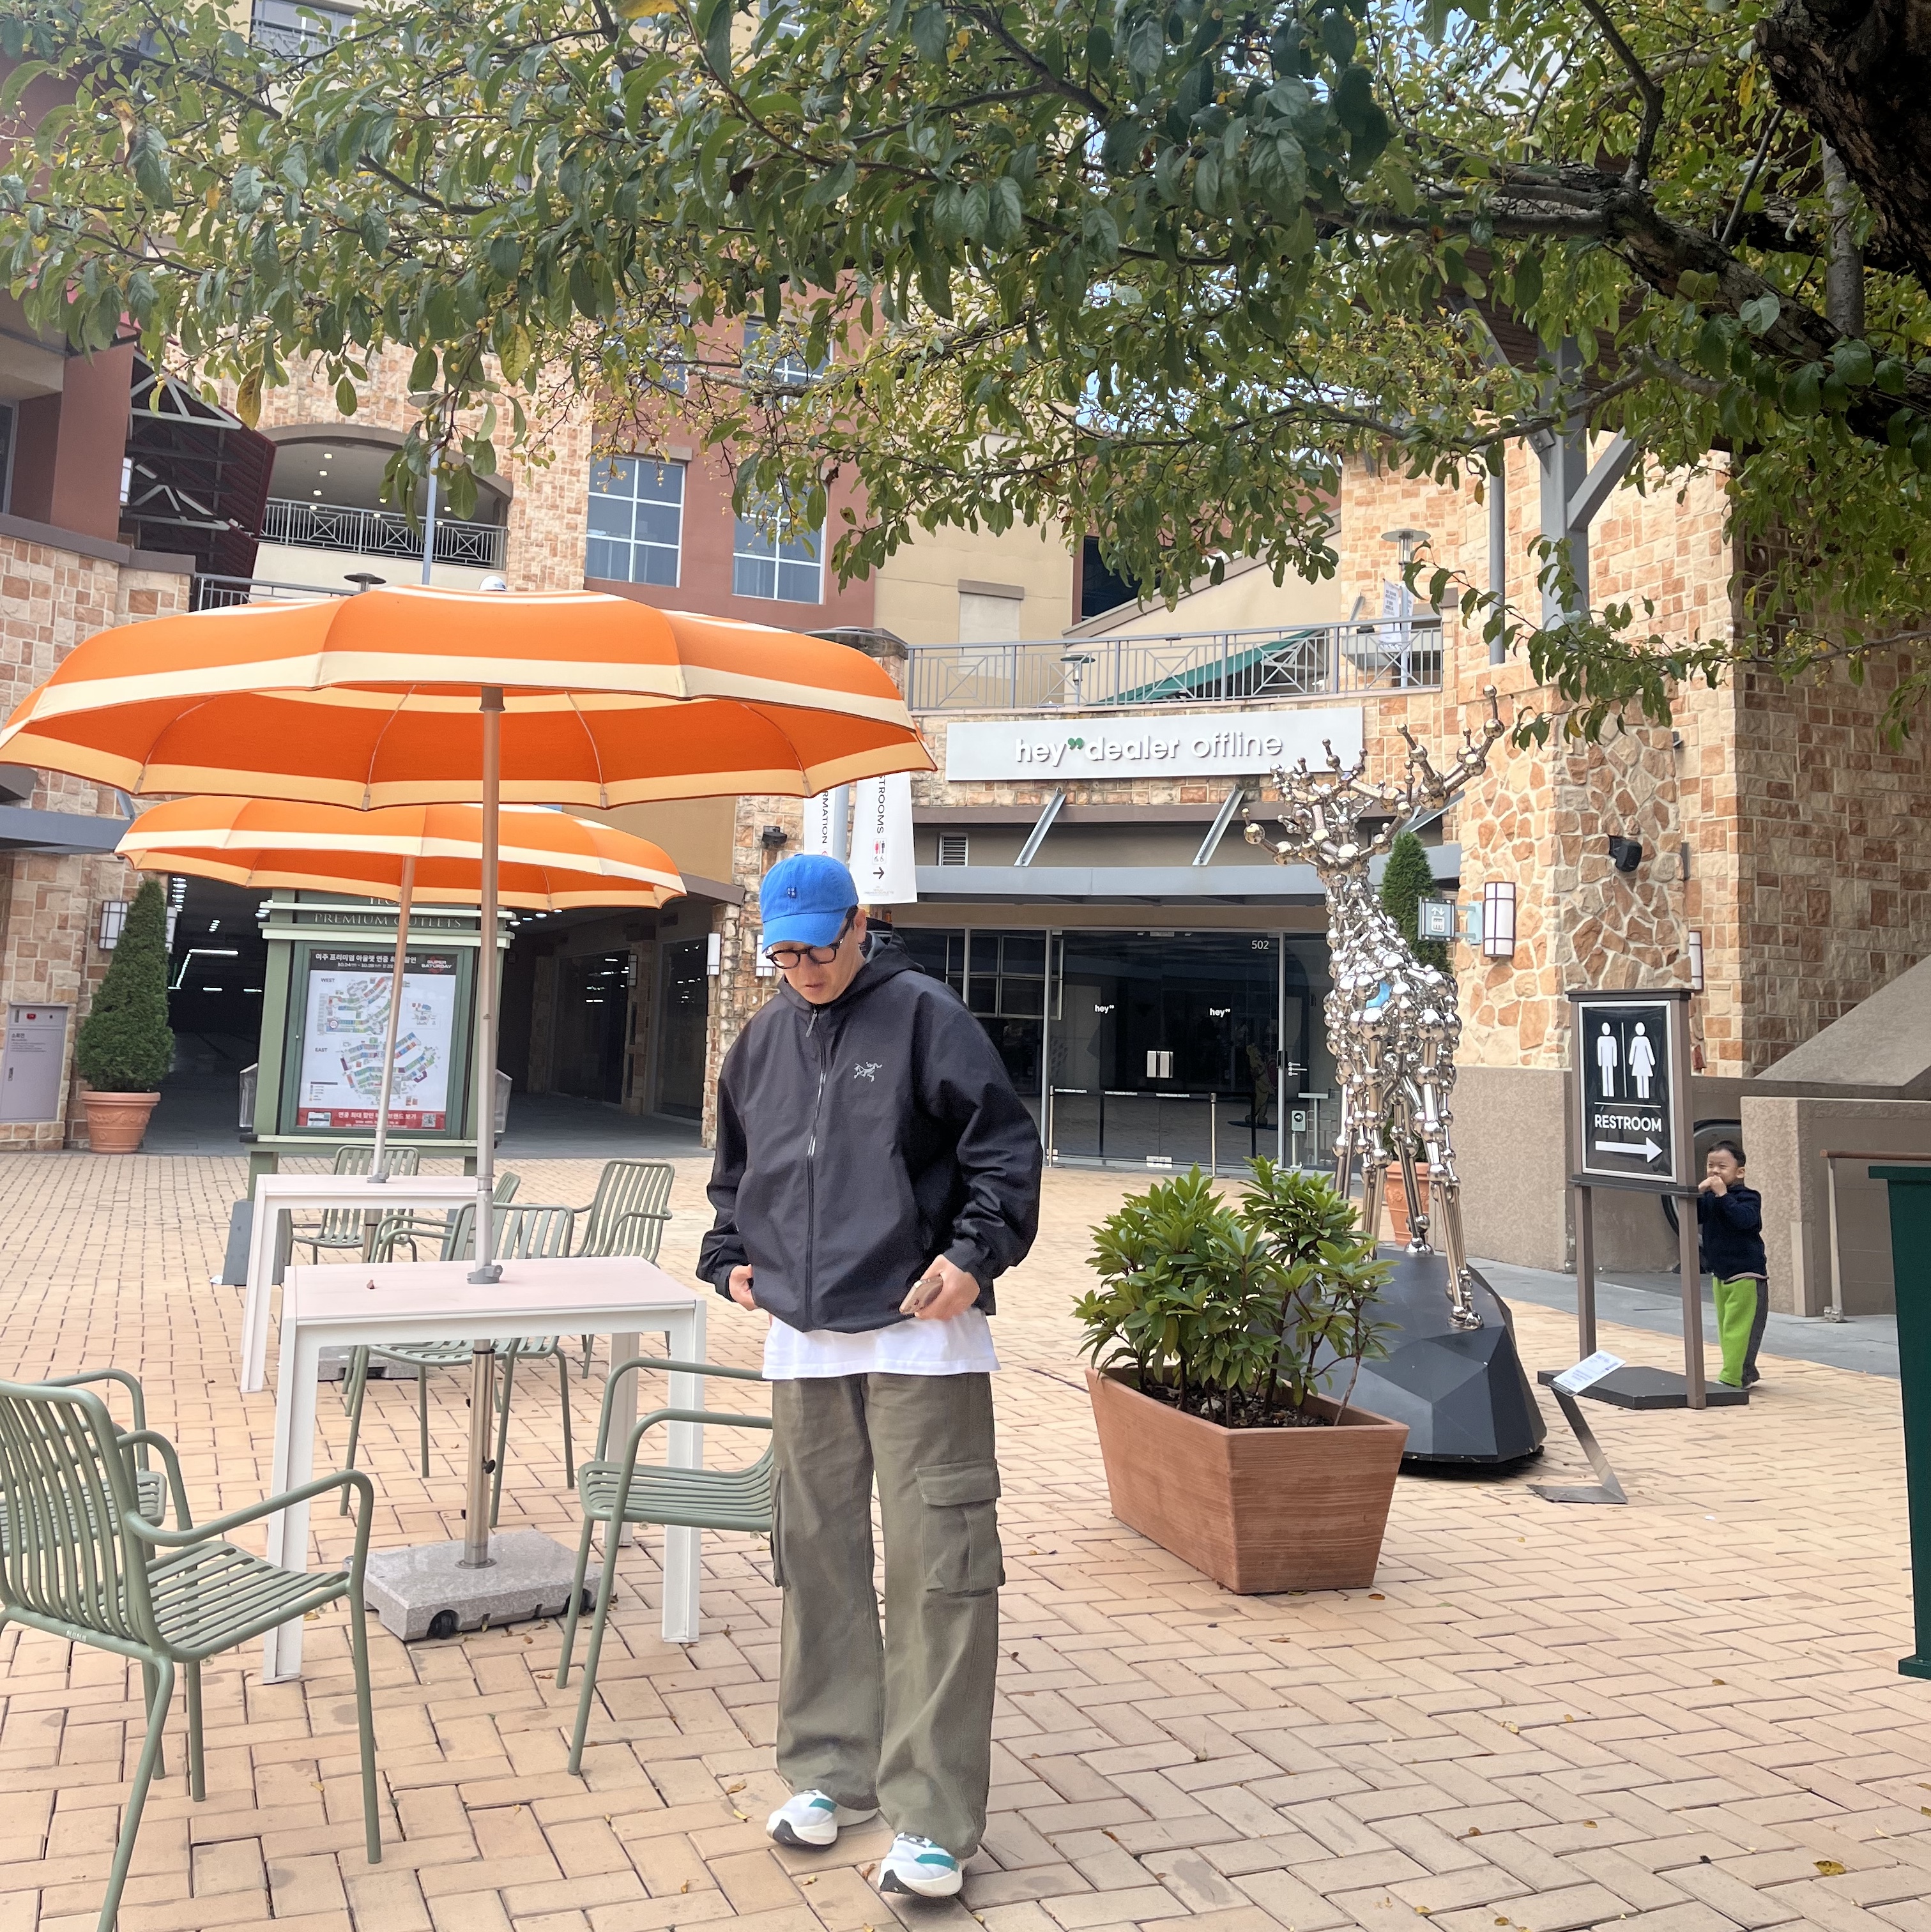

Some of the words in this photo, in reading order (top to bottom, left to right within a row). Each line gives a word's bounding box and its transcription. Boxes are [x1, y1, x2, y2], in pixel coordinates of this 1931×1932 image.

[1191, 731, 1283, 758] offline
[314, 913, 388, 926] PREMIUM
[1251, 939, 1270, 950] 502
[330, 954, 355, 962] 프리미엄
[356, 954, 375, 962] 아울렛
[1594, 1113, 1662, 1132] RESTROOM
